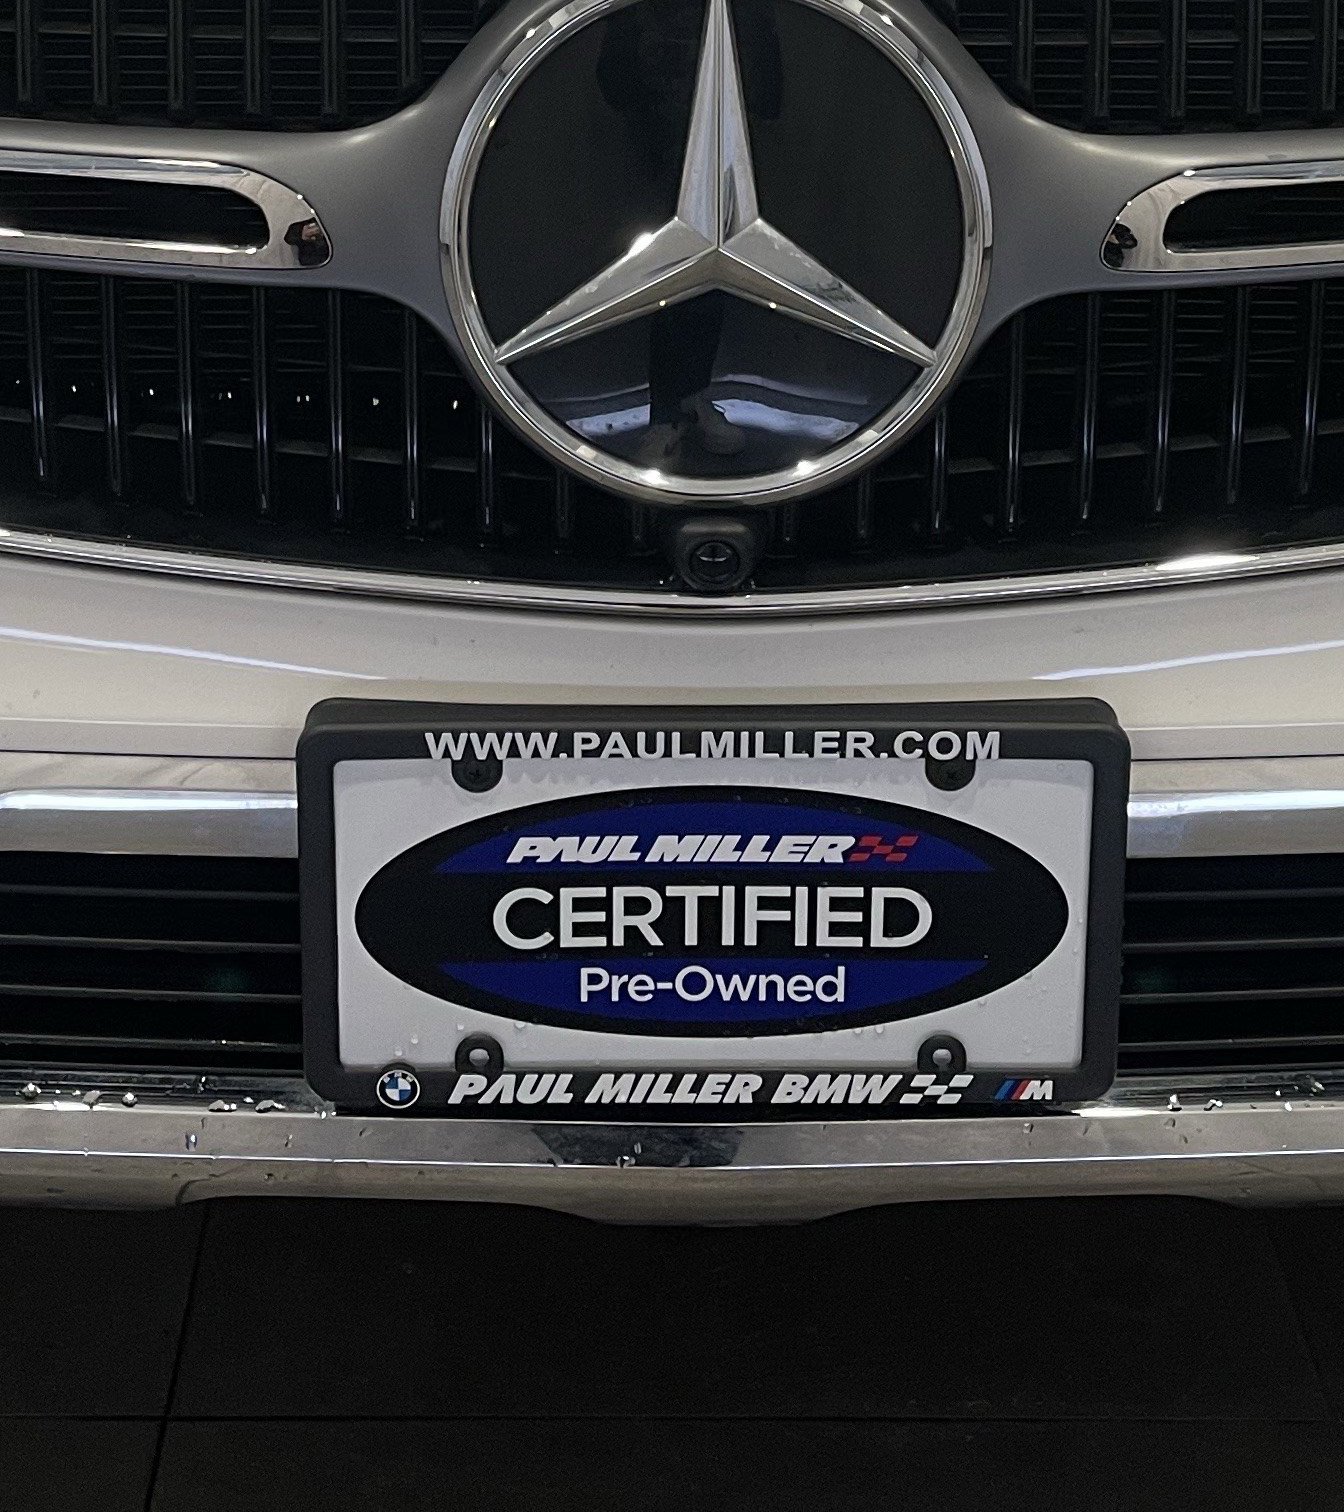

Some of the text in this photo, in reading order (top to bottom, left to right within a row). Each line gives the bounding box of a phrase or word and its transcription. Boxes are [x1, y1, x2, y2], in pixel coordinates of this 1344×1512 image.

[424, 731, 1001, 761] WWW.PAULMILLER.COM
[506, 834, 855, 863] PAUL MILLER
[493, 885, 933, 950] CERTIFIED
[580, 965, 846, 1003] Pre-Owned
[447, 1073, 903, 1104] PAUL MILLER BMW
